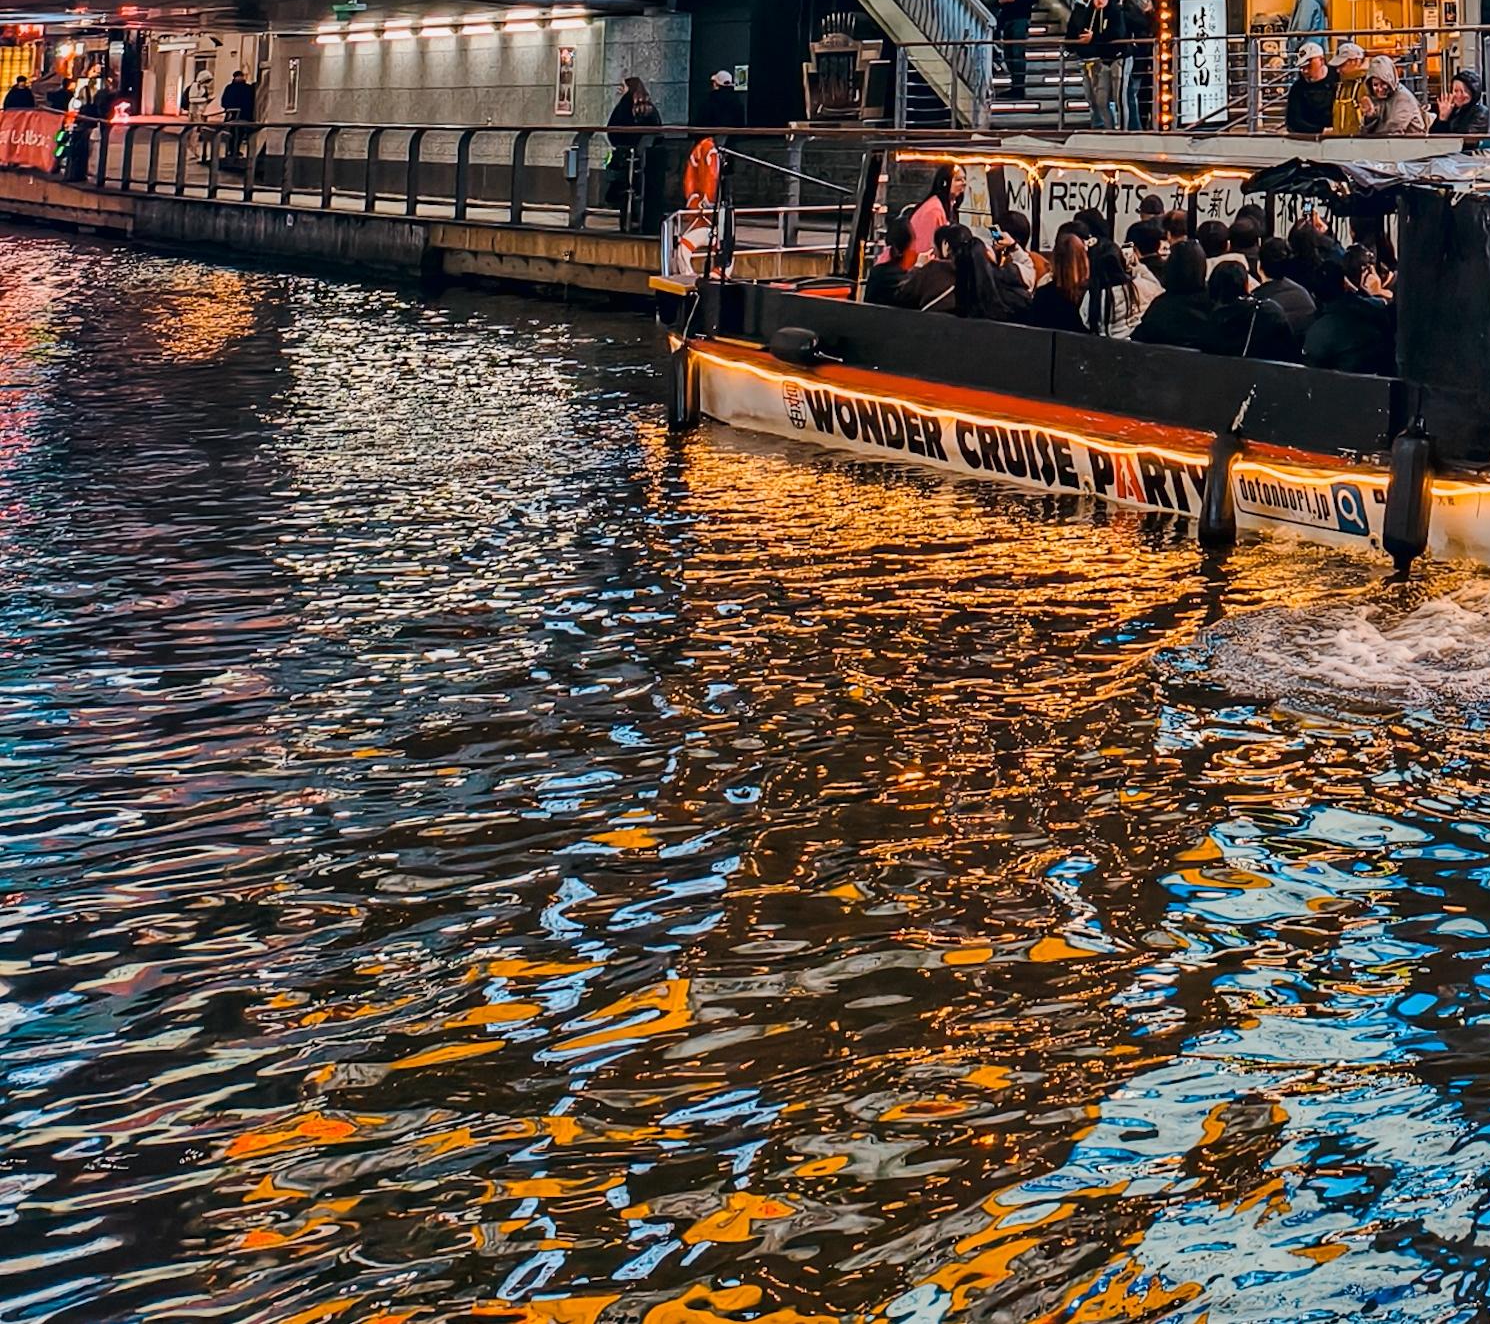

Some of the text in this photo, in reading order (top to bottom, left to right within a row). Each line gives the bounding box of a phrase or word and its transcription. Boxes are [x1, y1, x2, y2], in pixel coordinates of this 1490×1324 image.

[804, 387, 949, 462] WONDER
[956, 421, 1080, 490] CRUISE
[1238, 474, 1331, 522] dotonbori.jp
